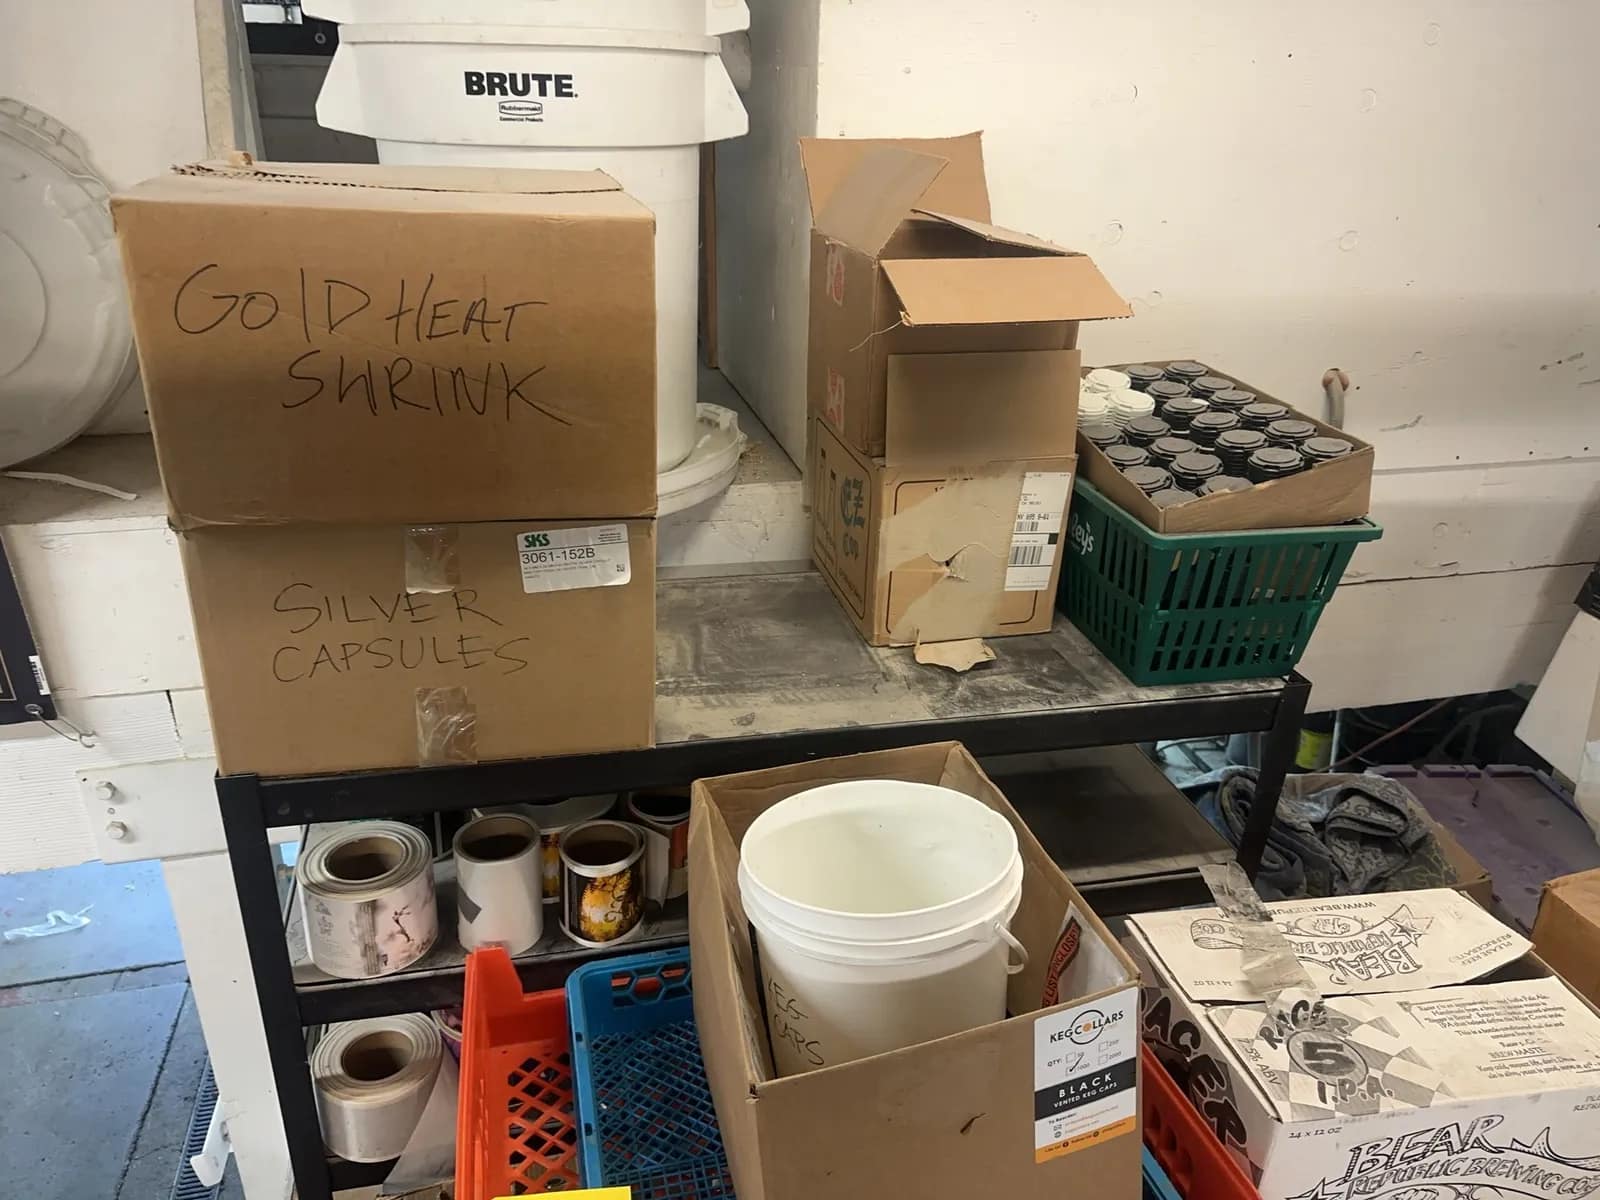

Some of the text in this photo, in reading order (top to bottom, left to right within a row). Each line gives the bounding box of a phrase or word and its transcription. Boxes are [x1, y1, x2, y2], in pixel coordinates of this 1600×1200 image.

[385, 273, 548, 344] HEAT
[282, 350, 572, 426] SHRINK
[521, 547, 596, 564] 3061-152B
[523, 532, 551, 549] SKS
[273, 582, 504, 634] SILVER
[272, 635, 530, 683] CAPSULES
[1318, 932, 1394, 957] REPUBLIC
[1141, 988, 1249, 1147] ACER
[1302, 1041, 1355, 1076] 5
[1513, 1046, 1548, 1056] MASTE
[1059, 1072, 1113, 1098] BLACK
[1256, 1063, 1282, 1085] ABV
[1053, 1082, 1118, 1108] VENTED KEG CAPS
[1345, 1113, 1506, 1182] BEAR
[1351, 1157, 1468, 1194] REPUBLIC
[1462, 1157, 1563, 1190] BREWING
